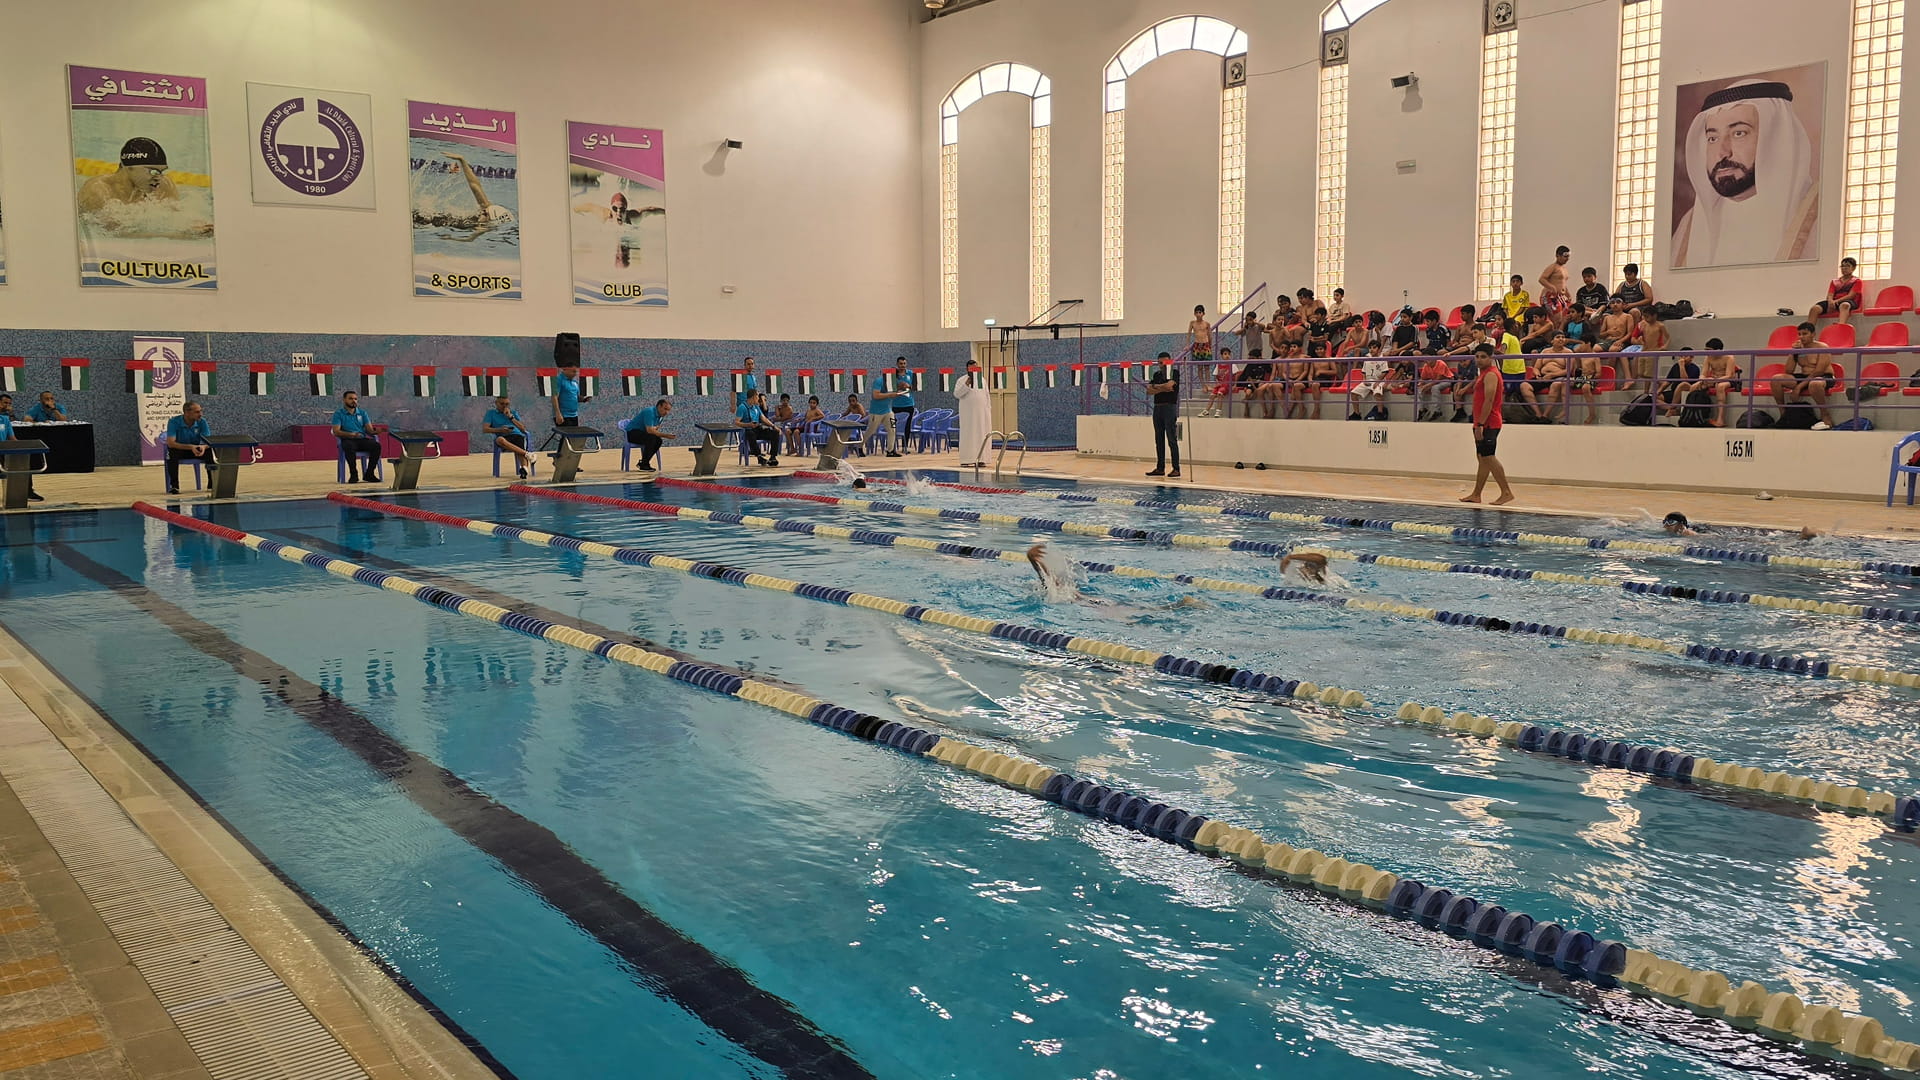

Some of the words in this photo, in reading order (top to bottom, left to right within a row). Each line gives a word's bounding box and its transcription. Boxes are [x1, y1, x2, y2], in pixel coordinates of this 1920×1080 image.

[84, 75, 195, 102] الثقافي
[422, 112, 507, 133] الذيد
[582, 132, 652, 150] نادي
[305, 185, 326, 193] 1980
[101, 261, 209, 279] CULTURAL
[431, 274, 443, 287] &
[447, 275, 511, 290] SPORTS
[603, 284, 641, 297] CLUB
[1369, 430, 1380, 443] 1.85
[1381, 430, 1387, 443] M
[255, 448, 263, 459] 3
[1726, 440, 1743, 457] 1.65
[1745, 440, 1753, 457] M
